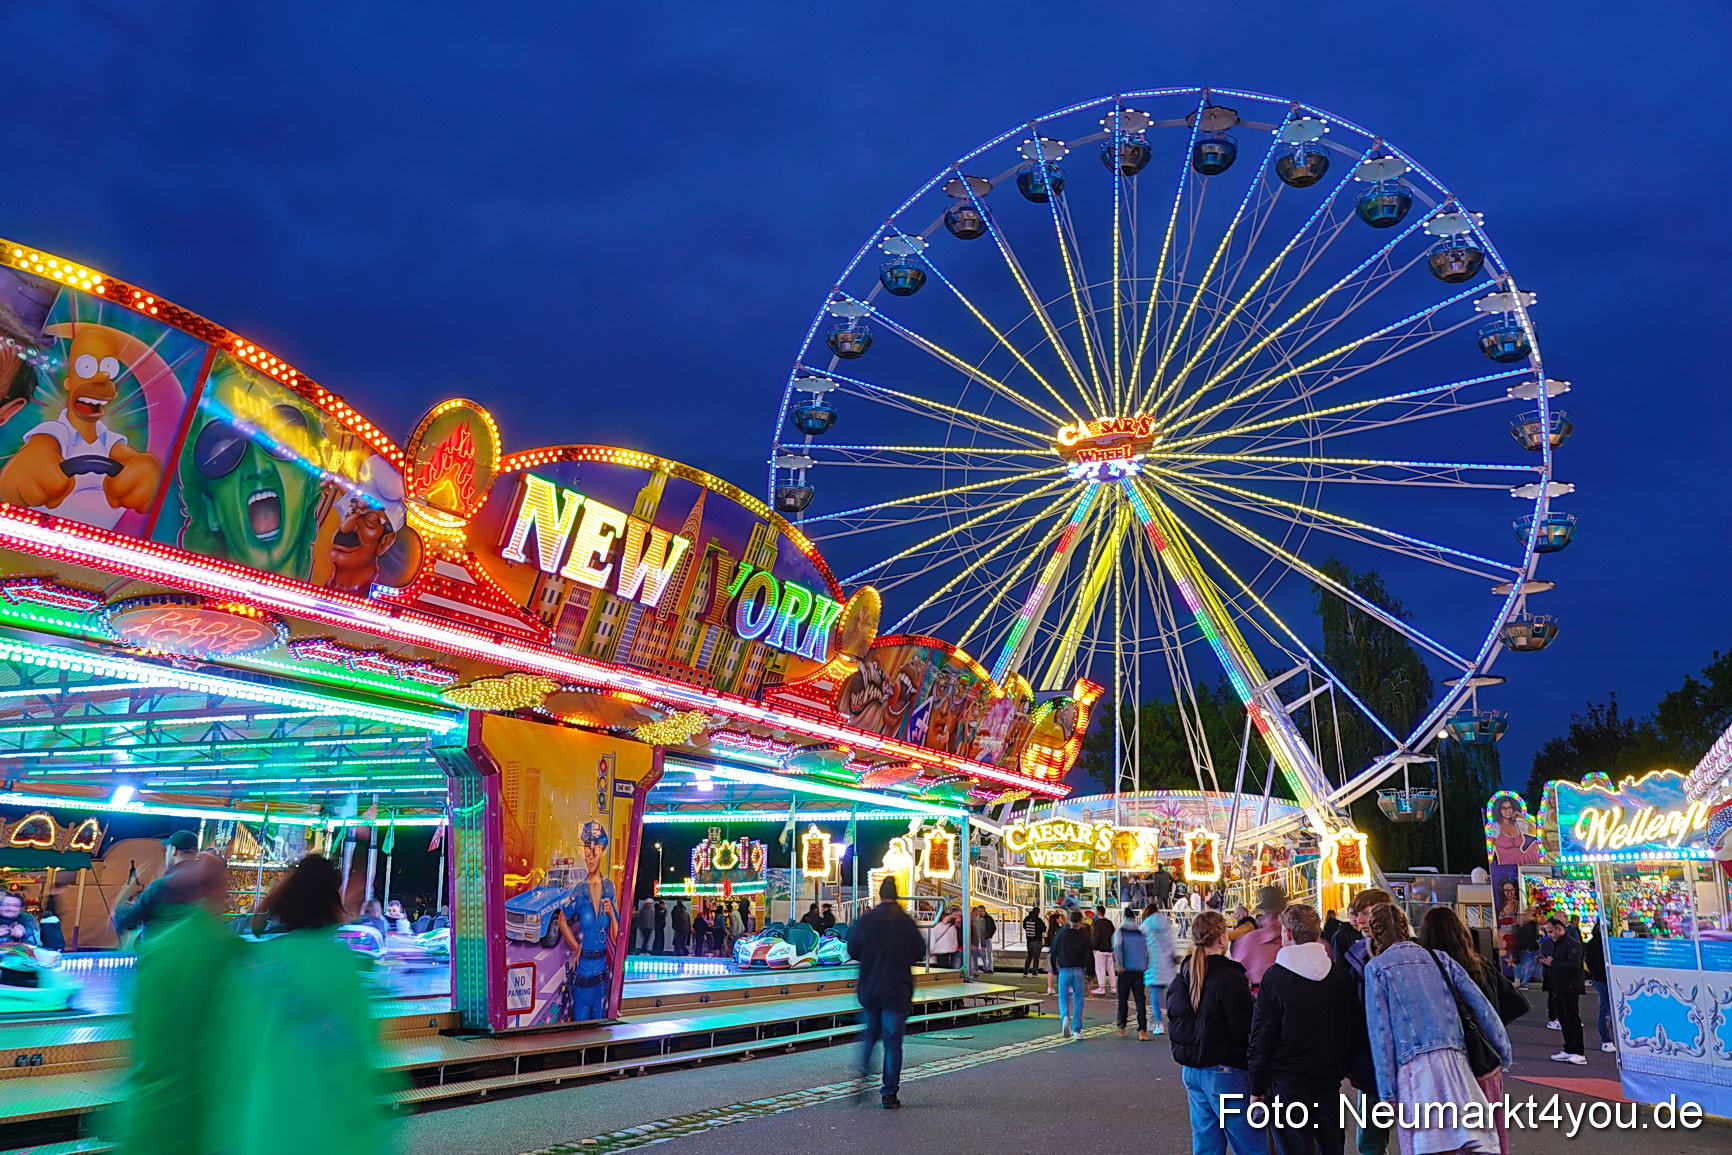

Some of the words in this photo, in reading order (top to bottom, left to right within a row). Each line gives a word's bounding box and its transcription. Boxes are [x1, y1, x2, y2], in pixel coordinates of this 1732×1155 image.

[1076, 444, 1135, 464] WHEEL
[502, 473, 690, 607] NEW
[702, 550, 845, 663] YORK
[122, 623, 249, 653] ACTIVE
[152, 611, 262, 641] RADIO
[1005, 822, 1115, 853] CAESAR'S
[1028, 848, 1090, 867] WHEEL
[508, 987, 531, 997] PARKING
[514, 975, 526, 987] NO
